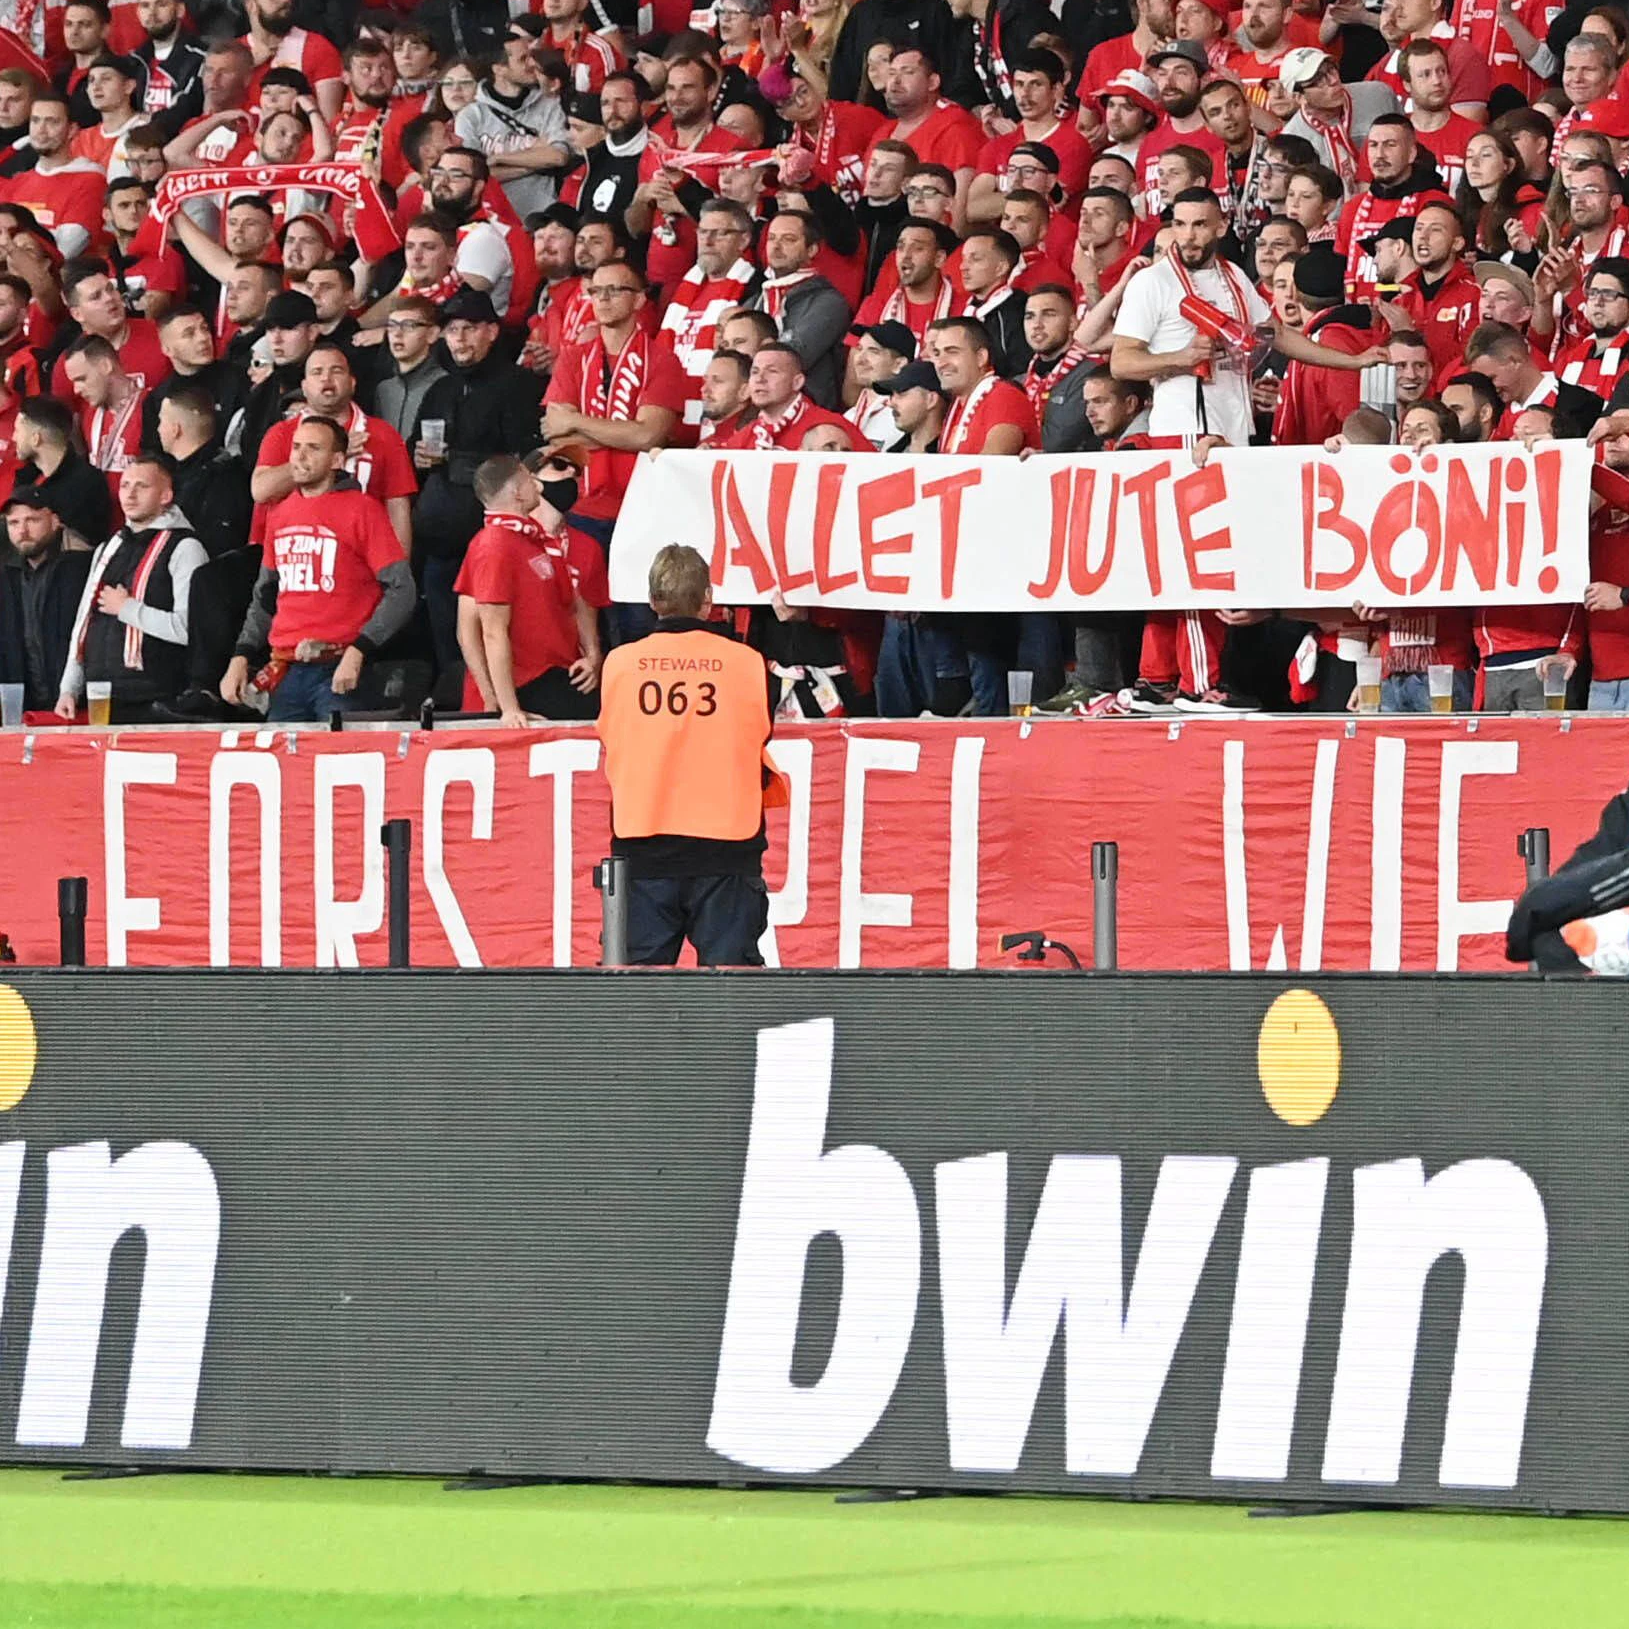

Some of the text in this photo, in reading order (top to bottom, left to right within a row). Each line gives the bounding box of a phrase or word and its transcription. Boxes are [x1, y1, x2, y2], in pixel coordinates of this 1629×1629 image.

[292, 535, 323, 555] ZUM
[710, 460, 981, 599] ALLET
[1028, 461, 1235, 598] JUTE
[637, 656, 723, 673] STEWARD
[638, 681, 718, 717] 063
[706, 990, 1548, 1487] bwin
